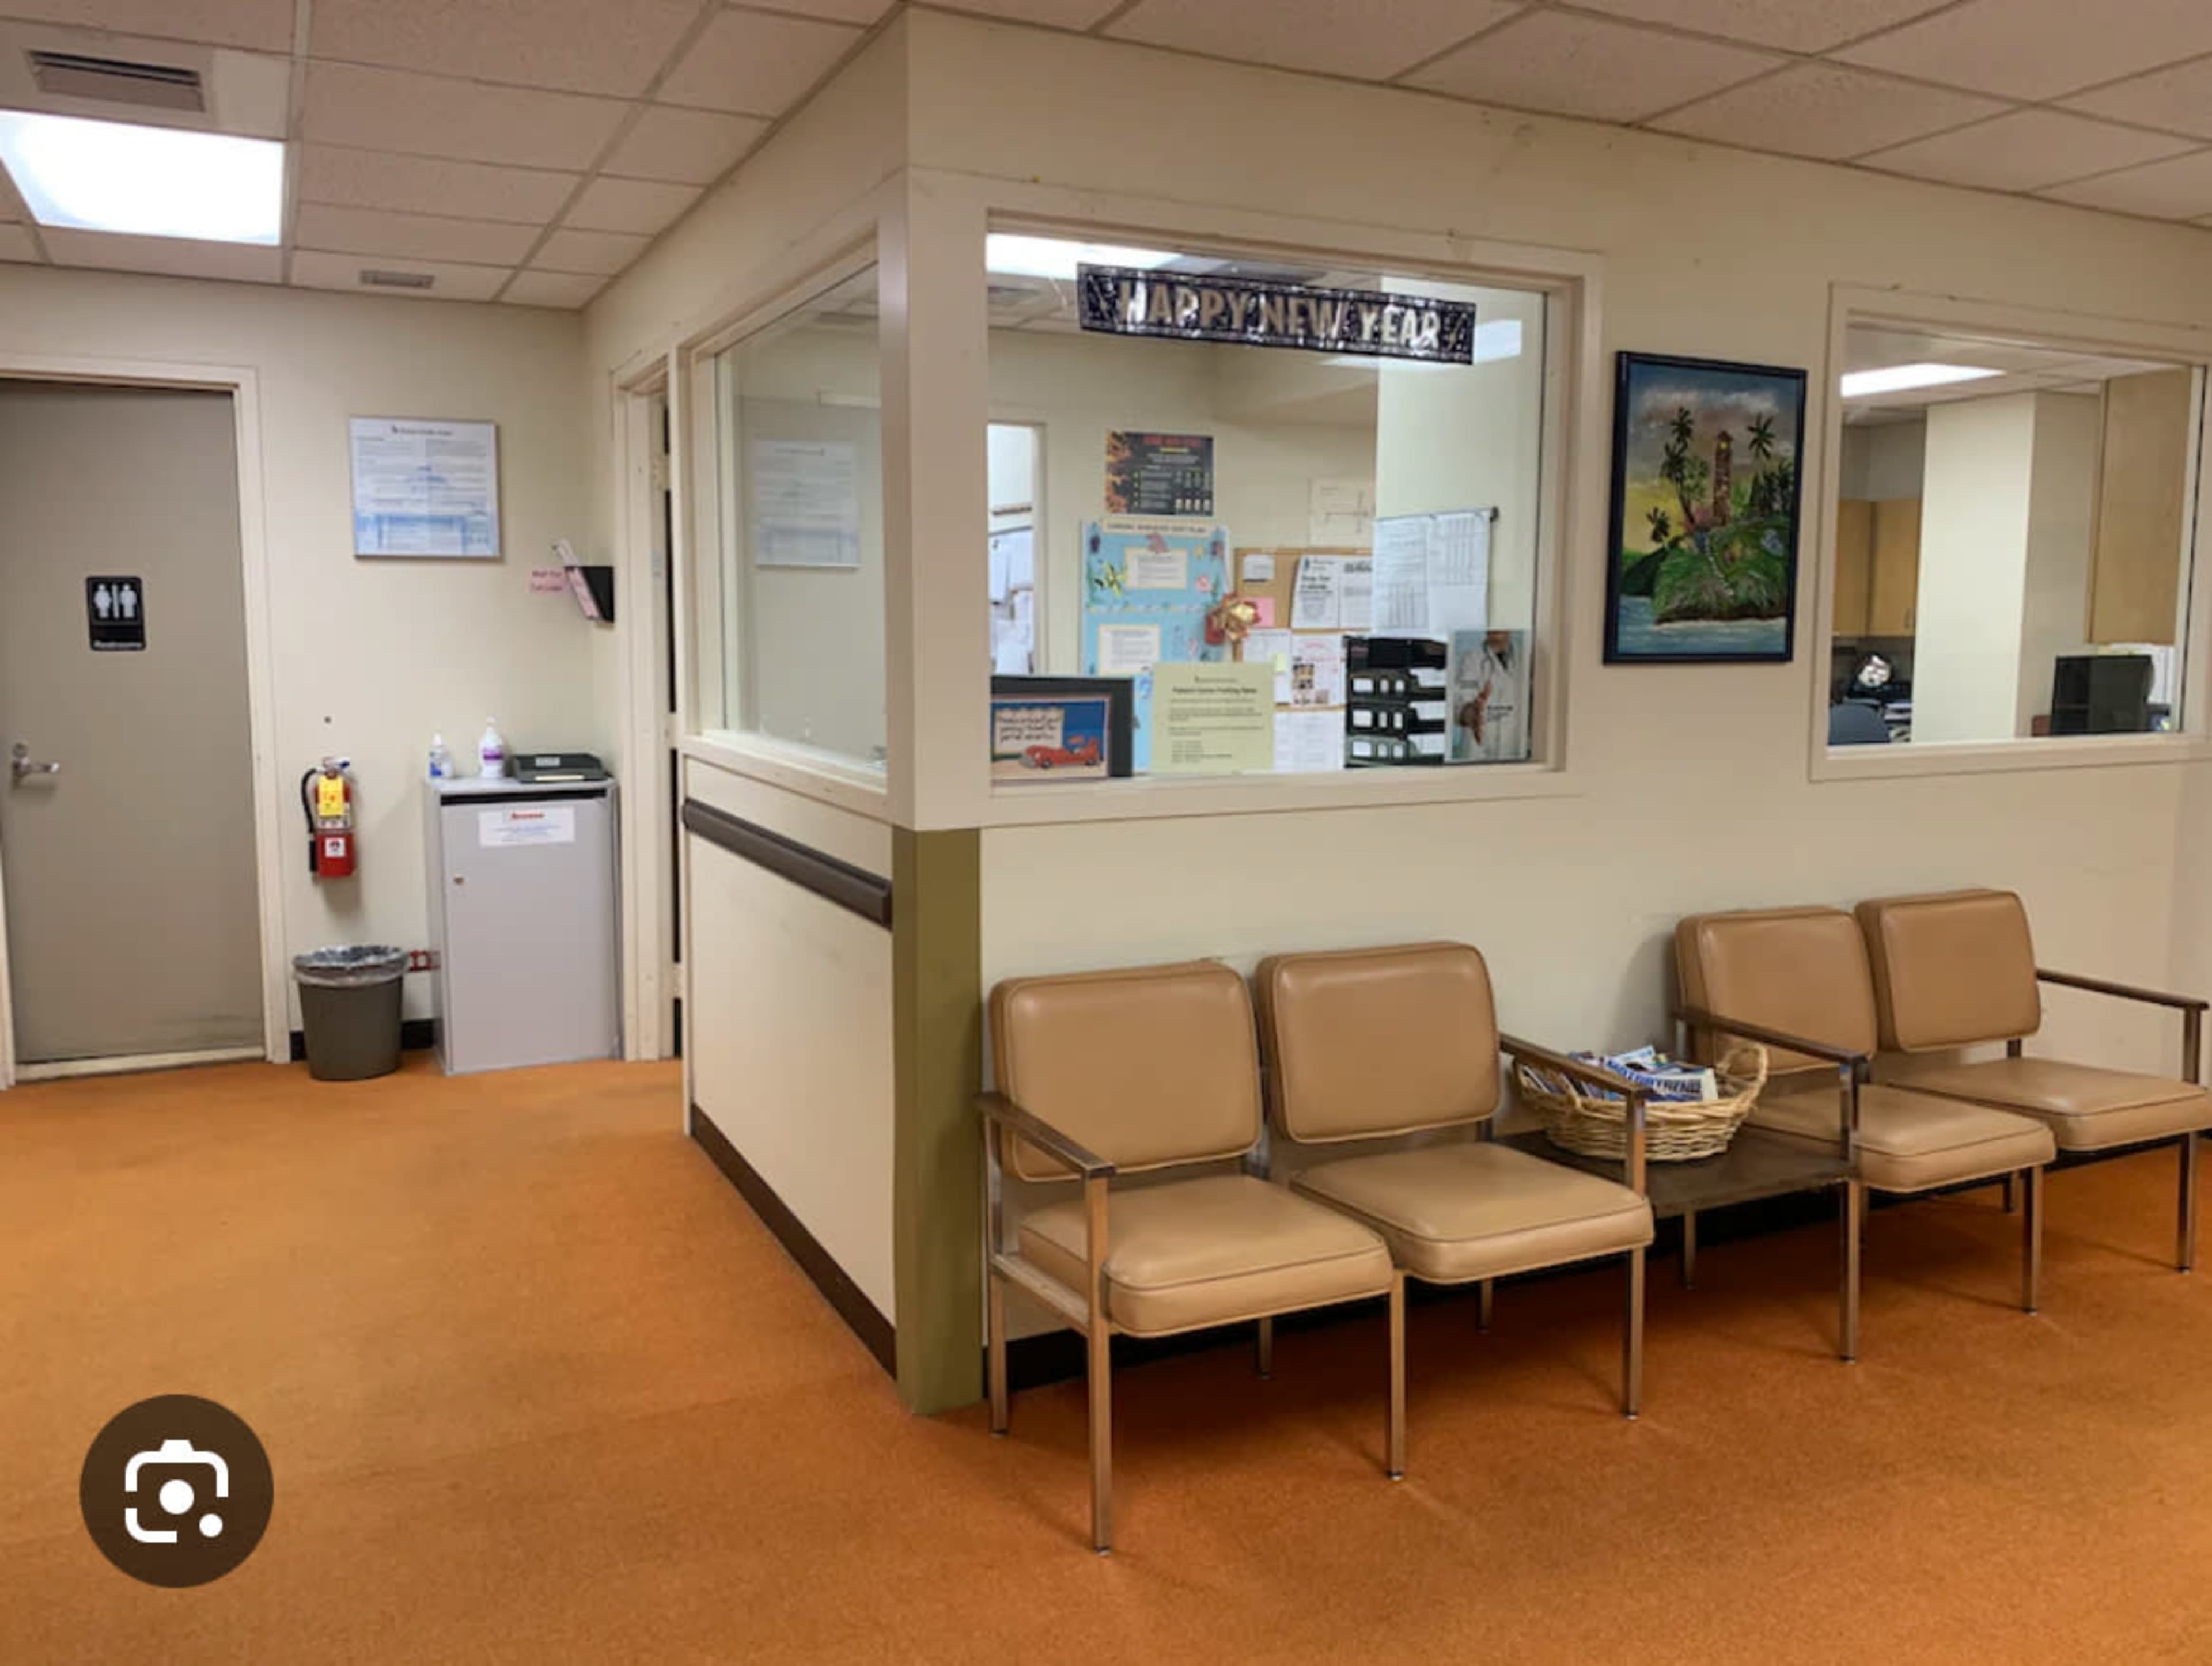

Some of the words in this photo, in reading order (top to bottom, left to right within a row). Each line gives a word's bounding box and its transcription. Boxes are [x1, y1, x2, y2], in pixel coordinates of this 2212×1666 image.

[1118, 280, 1251, 333] HAPPY
[1262, 292, 1350, 341] NEW
[1358, 301, 1440, 350] YEAR
